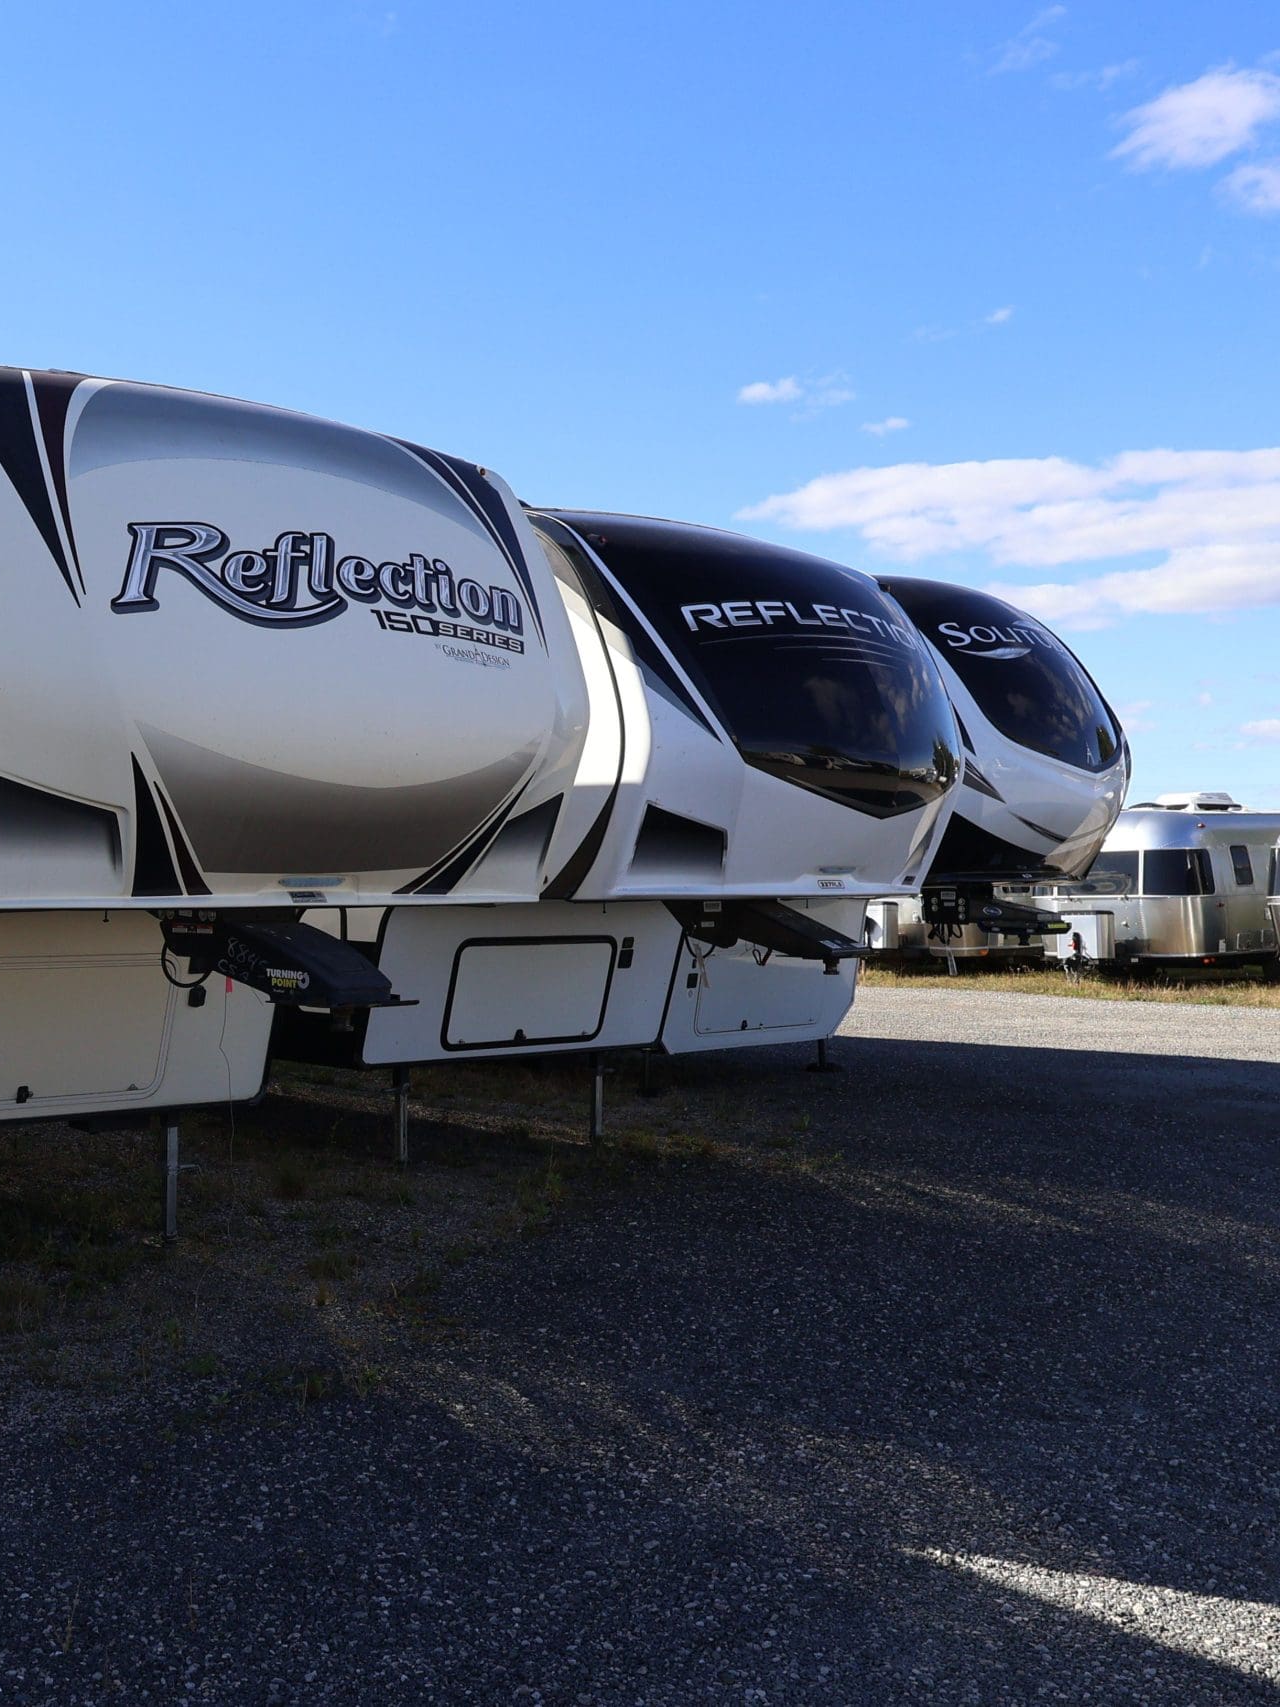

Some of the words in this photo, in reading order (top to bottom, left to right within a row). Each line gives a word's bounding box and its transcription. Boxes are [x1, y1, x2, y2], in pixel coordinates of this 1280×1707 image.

[110, 520, 525, 634] Reflection
[438, 621, 524, 654] SERIES
[937, 621, 1063, 653] SOLITU
[266, 968, 303, 980] TURNING
[271, 977, 297, 988] POINT
